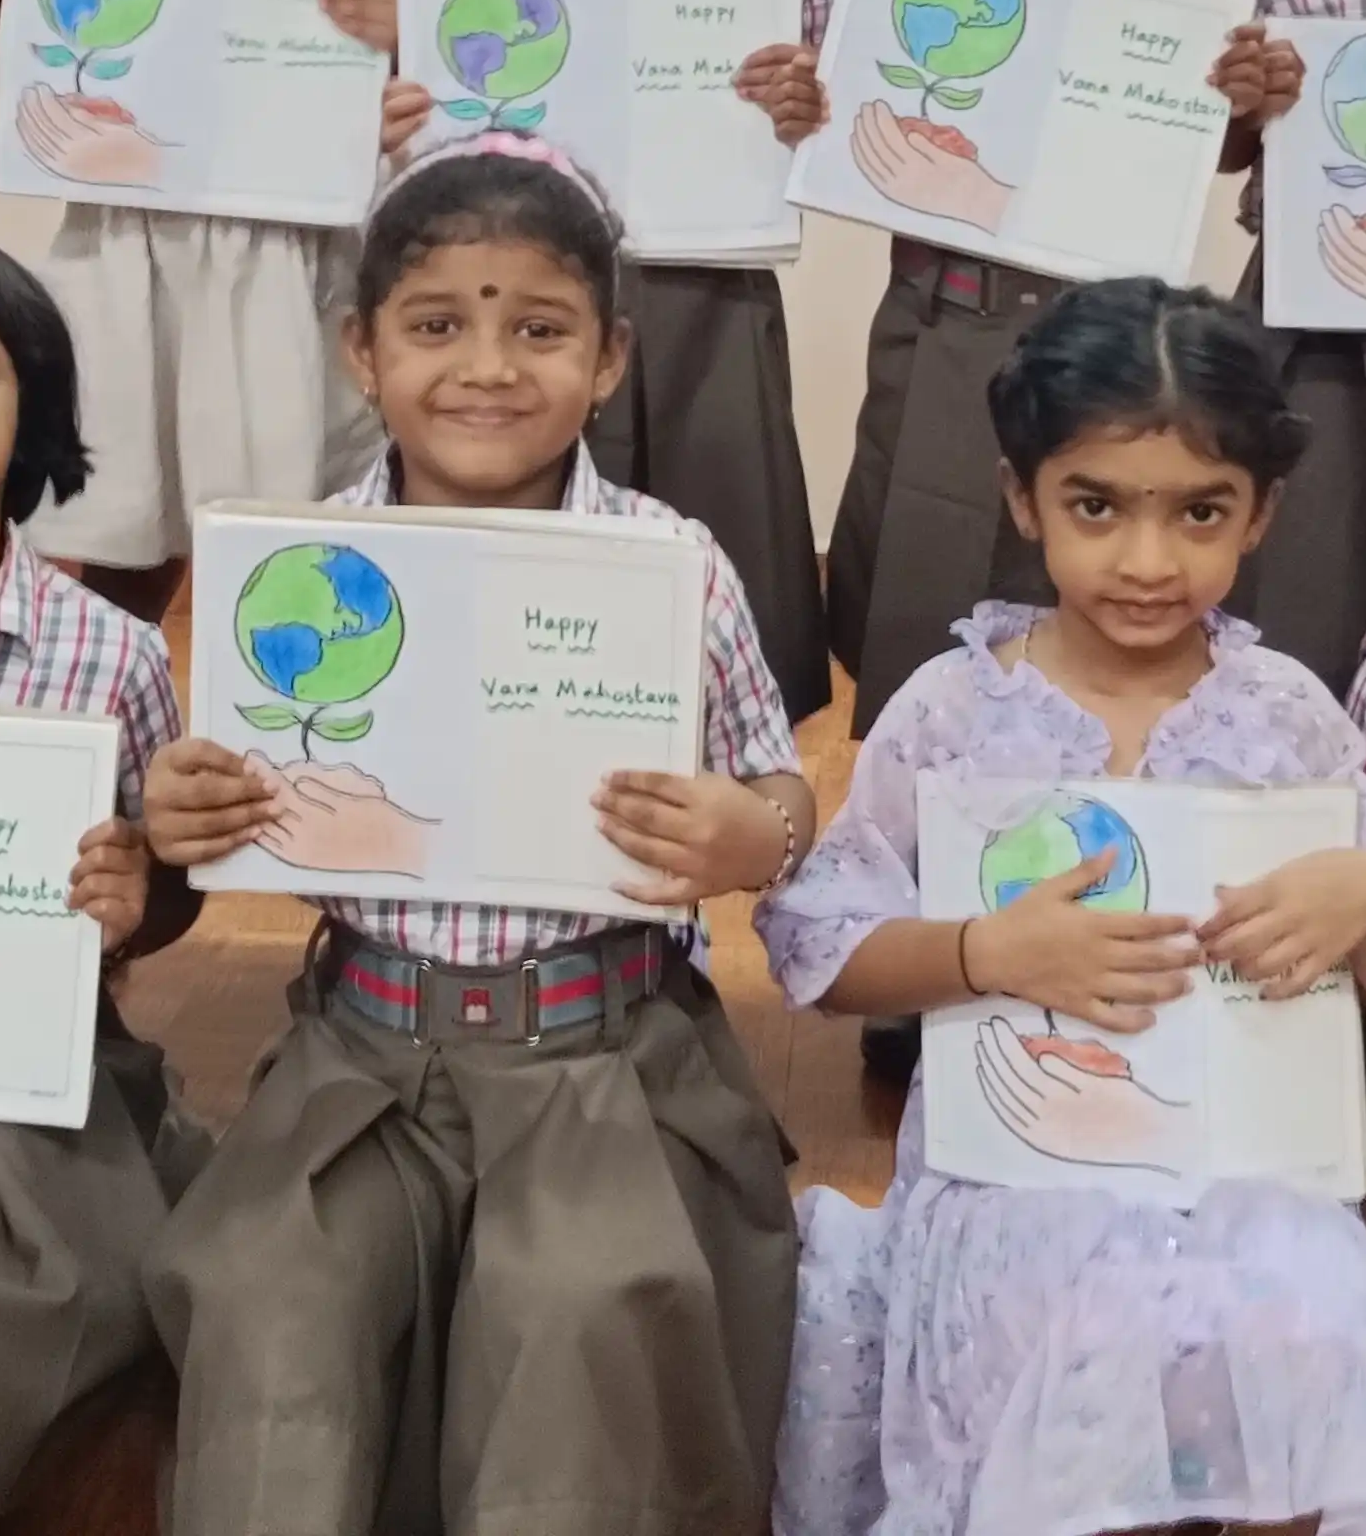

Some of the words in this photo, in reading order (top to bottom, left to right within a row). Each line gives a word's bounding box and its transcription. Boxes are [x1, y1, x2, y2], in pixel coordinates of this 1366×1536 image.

[675, 3, 736, 25] Happy
[1120, 22, 1182, 61] Happy
[631, 56, 683, 77] Vana
[1058, 68, 1110, 95] Vana
[524, 606, 599, 642] Happy
[480, 677, 539, 697] Vana
